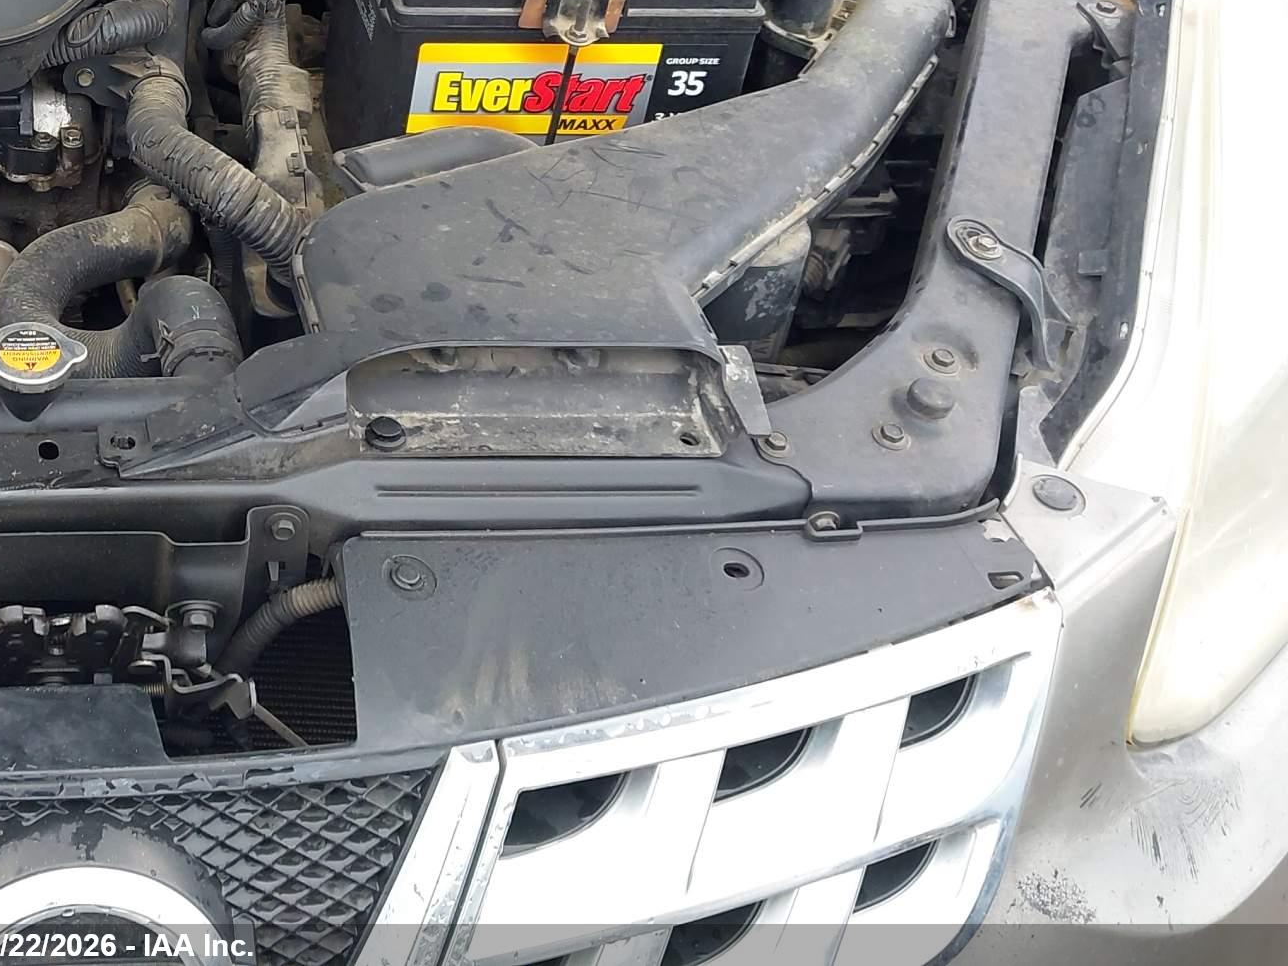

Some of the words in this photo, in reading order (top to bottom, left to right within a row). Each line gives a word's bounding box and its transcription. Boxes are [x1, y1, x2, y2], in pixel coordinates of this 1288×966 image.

[665, 57, 698, 65] GROUP
[699, 57, 721, 65] SIZE
[431, 70, 646, 114] EverStart
[667, 70, 708, 96] 35
[558, 118, 617, 131] MAXX
